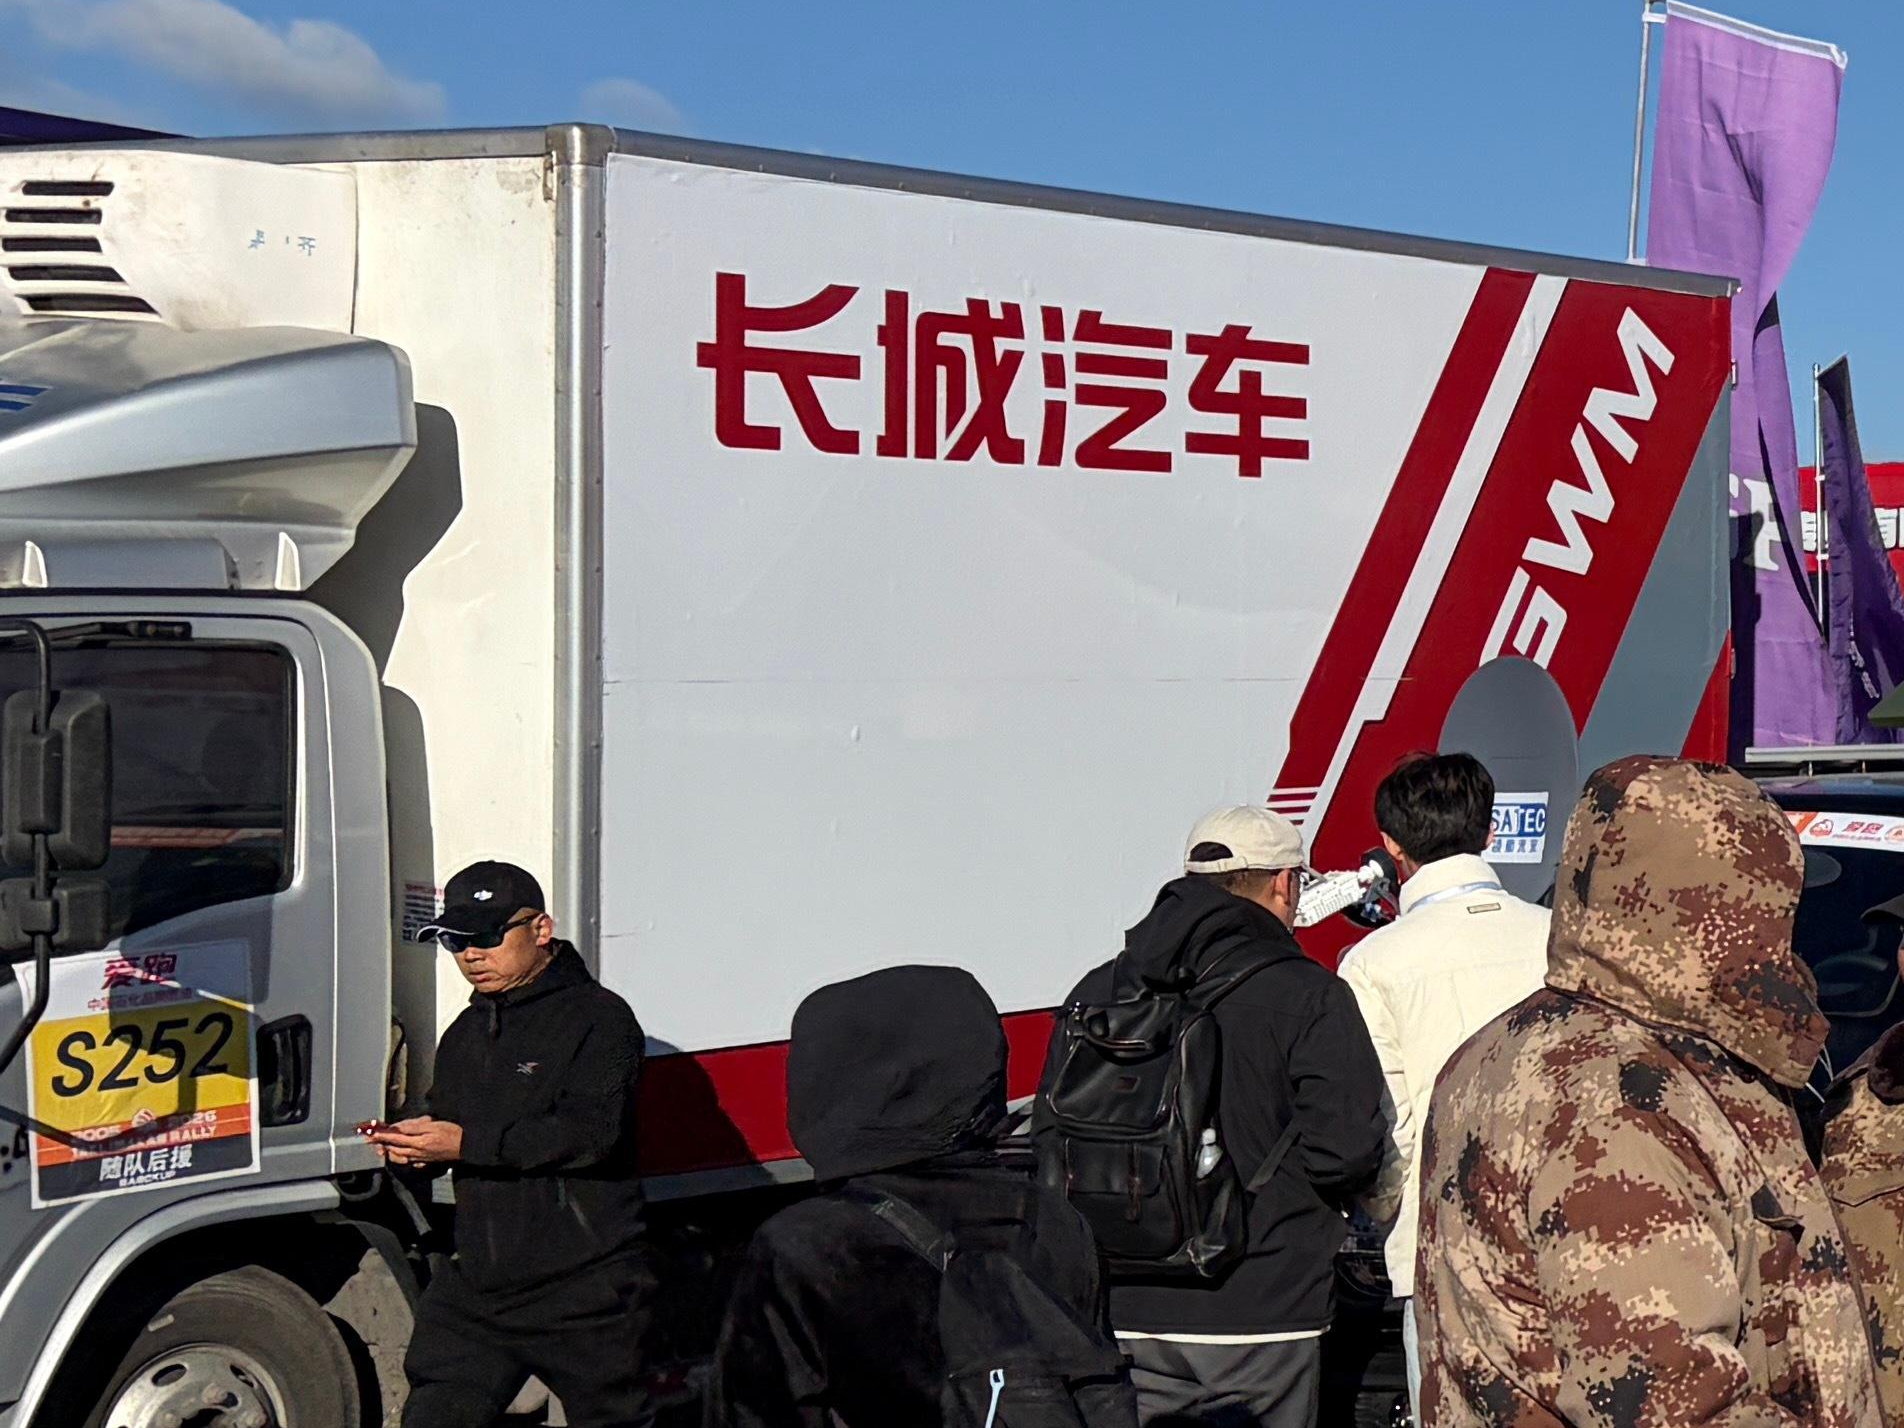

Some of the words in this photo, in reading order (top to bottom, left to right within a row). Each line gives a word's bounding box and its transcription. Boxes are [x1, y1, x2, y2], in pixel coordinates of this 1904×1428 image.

[696, 271, 1311, 478] 长城汽车
[1478, 306, 1675, 670] GWM
[1491, 808, 1546, 833] SATEC
[51, 1012, 233, 1098] S252
